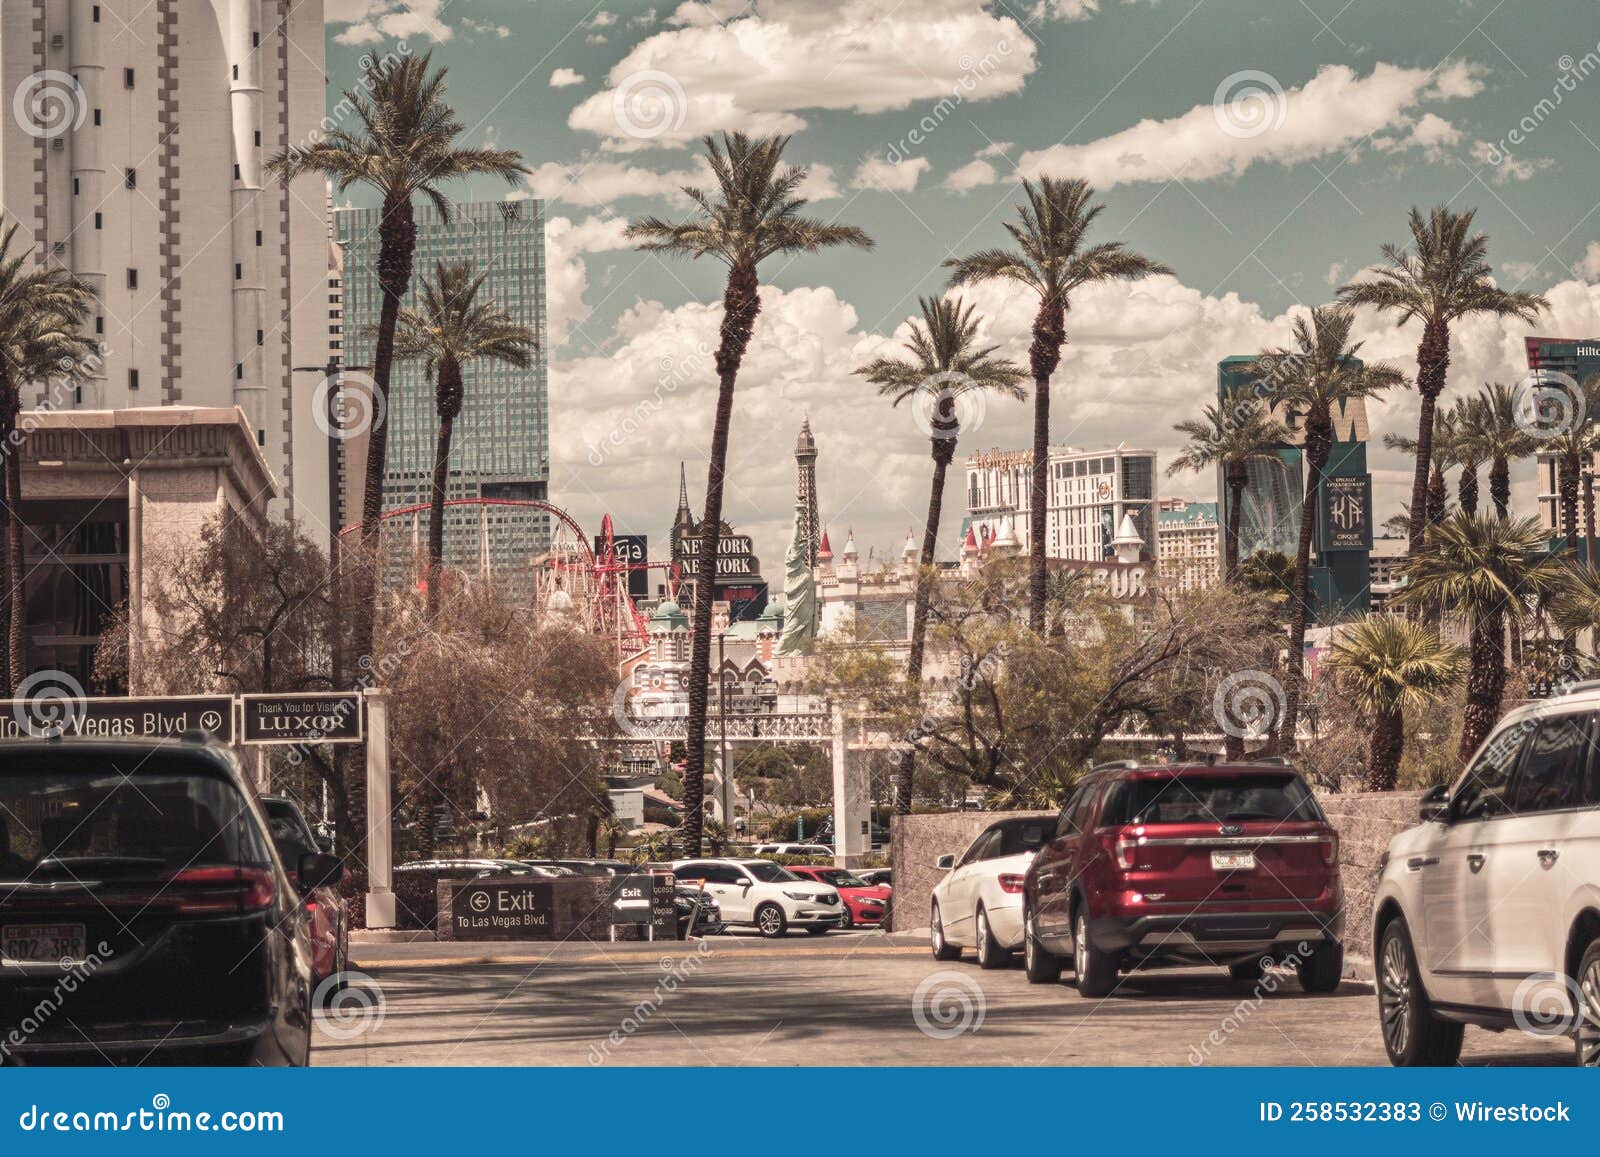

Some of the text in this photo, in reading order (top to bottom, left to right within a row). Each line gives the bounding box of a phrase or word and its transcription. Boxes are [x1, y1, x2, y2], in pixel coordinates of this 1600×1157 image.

[681, 538, 750, 554] NE YORK
[682, 558, 751, 574] NE YORK
[257, 703, 283, 713] Thank
[285, 702, 301, 713] You
[303, 702, 314, 713] for
[0, 716, 19, 738] To
[72, 714, 135, 737] Vegas
[143, 712, 187, 735] Blvd
[259, 715, 346, 730] LUXOR
[622, 888, 641, 897] Exit
[498, 890, 535, 911] Exit
[457, 916, 469, 928] To
[472, 915, 489, 927] Las
[491, 914, 521, 928] Vegas
